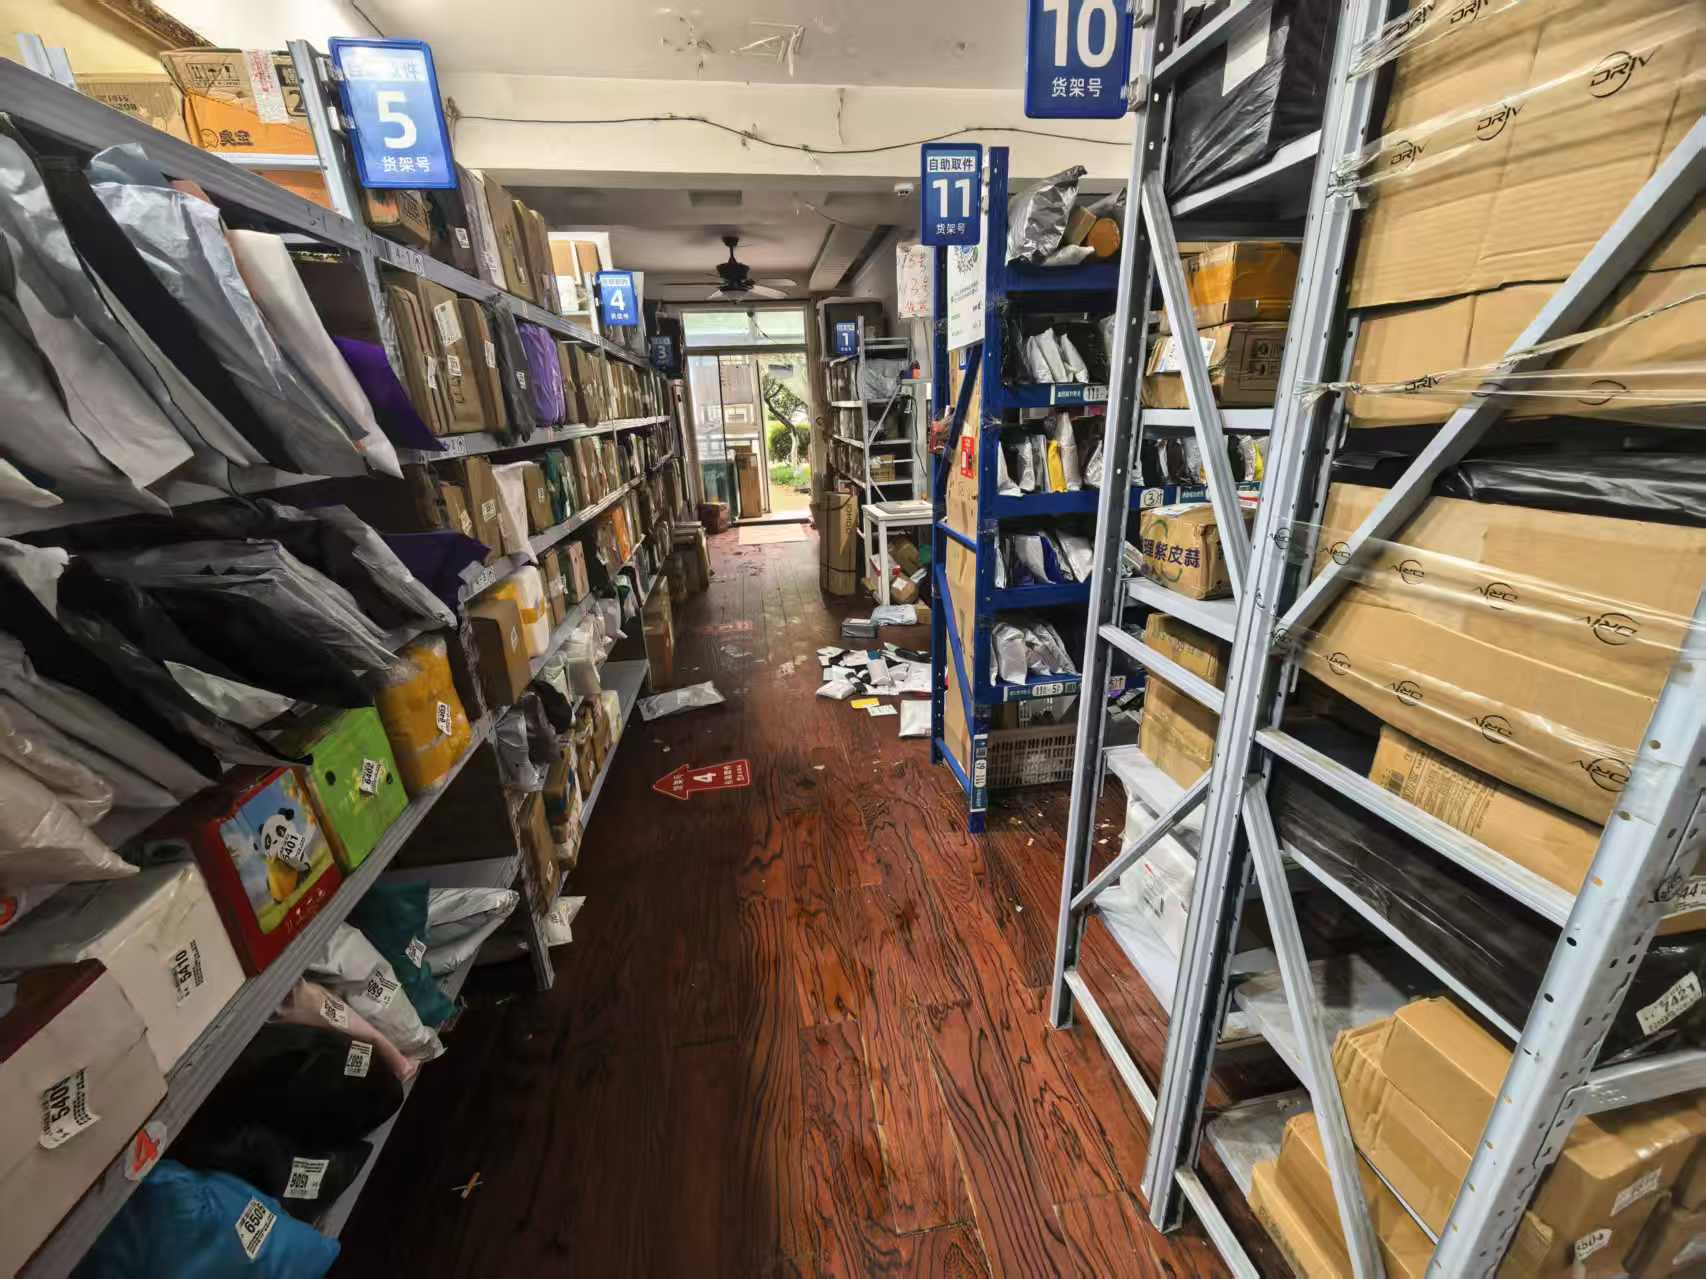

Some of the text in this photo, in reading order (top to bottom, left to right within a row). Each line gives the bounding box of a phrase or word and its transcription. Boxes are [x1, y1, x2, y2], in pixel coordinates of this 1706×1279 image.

[1043, 0, 1117, 67] 10
[1589, 47, 1656, 88] DRIV
[1051, 77, 1103, 97] 货架号
[377, 90, 417, 149] 5
[1476, 103, 1525, 132] DRIV
[382, 155, 431, 173] 货架号
[929, 157, 974, 171] 自助取件
[932, 178, 970, 218] 11
[935, 222, 966, 235] 货架号
[609, 288, 626, 311] 4
[842, 332, 849, 347] 1
[657, 345, 668, 360] 3
[692, 772, 716, 783] 4
[175, 949, 192, 985] 5410
[133, 1129, 161, 1174] 4
